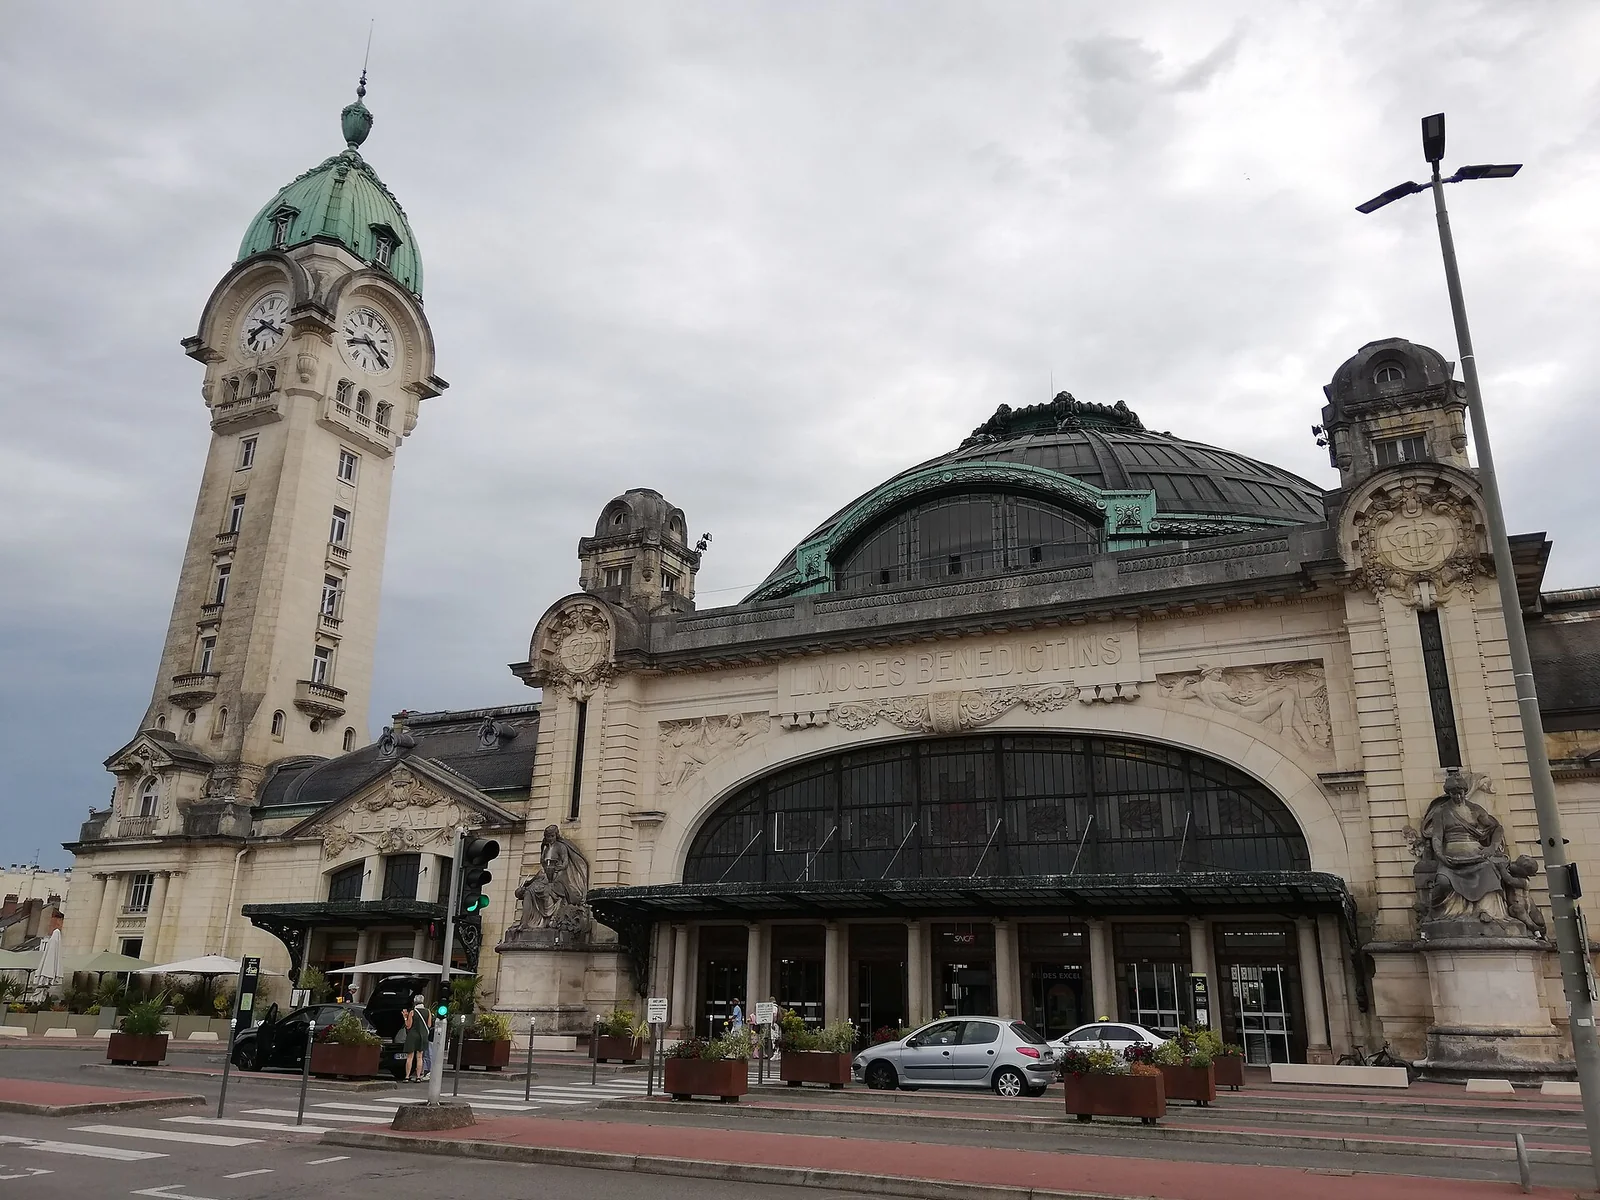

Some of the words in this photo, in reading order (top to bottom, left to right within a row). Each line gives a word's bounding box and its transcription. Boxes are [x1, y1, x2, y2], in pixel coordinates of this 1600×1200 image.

[790, 656, 906, 697] LIMOGES
[916, 633, 1122, 685] BENEDICTINS
[358, 808, 445, 830] DEPART
[953, 934, 975, 943] SNCF
